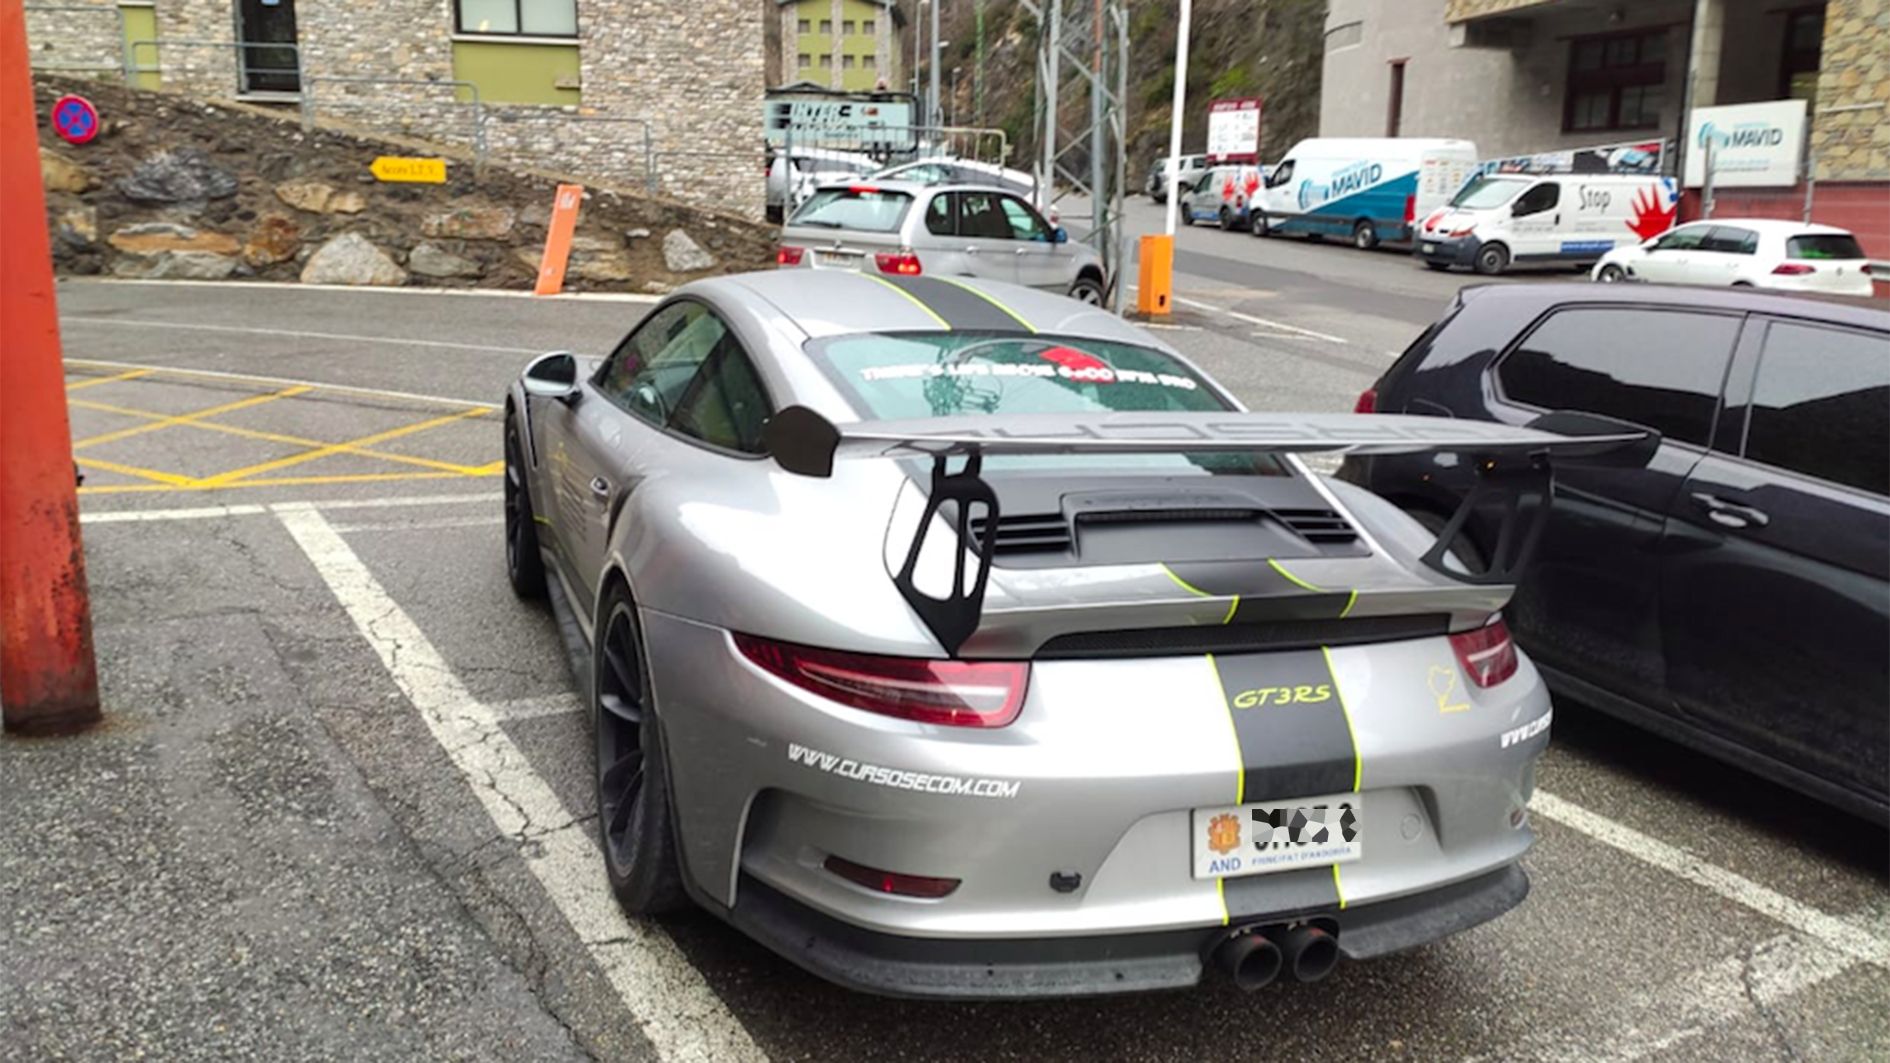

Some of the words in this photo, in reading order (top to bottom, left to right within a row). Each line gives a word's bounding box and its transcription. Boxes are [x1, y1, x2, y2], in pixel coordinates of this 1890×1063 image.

[1731, 128, 1783, 148] MAVID
[1331, 163, 1382, 199] MAVID
[1579, 184, 1611, 214] Stop
[788, 742, 1021, 798] WWW.CURSOSECOM.COM
[1209, 857, 1242, 874] AND
